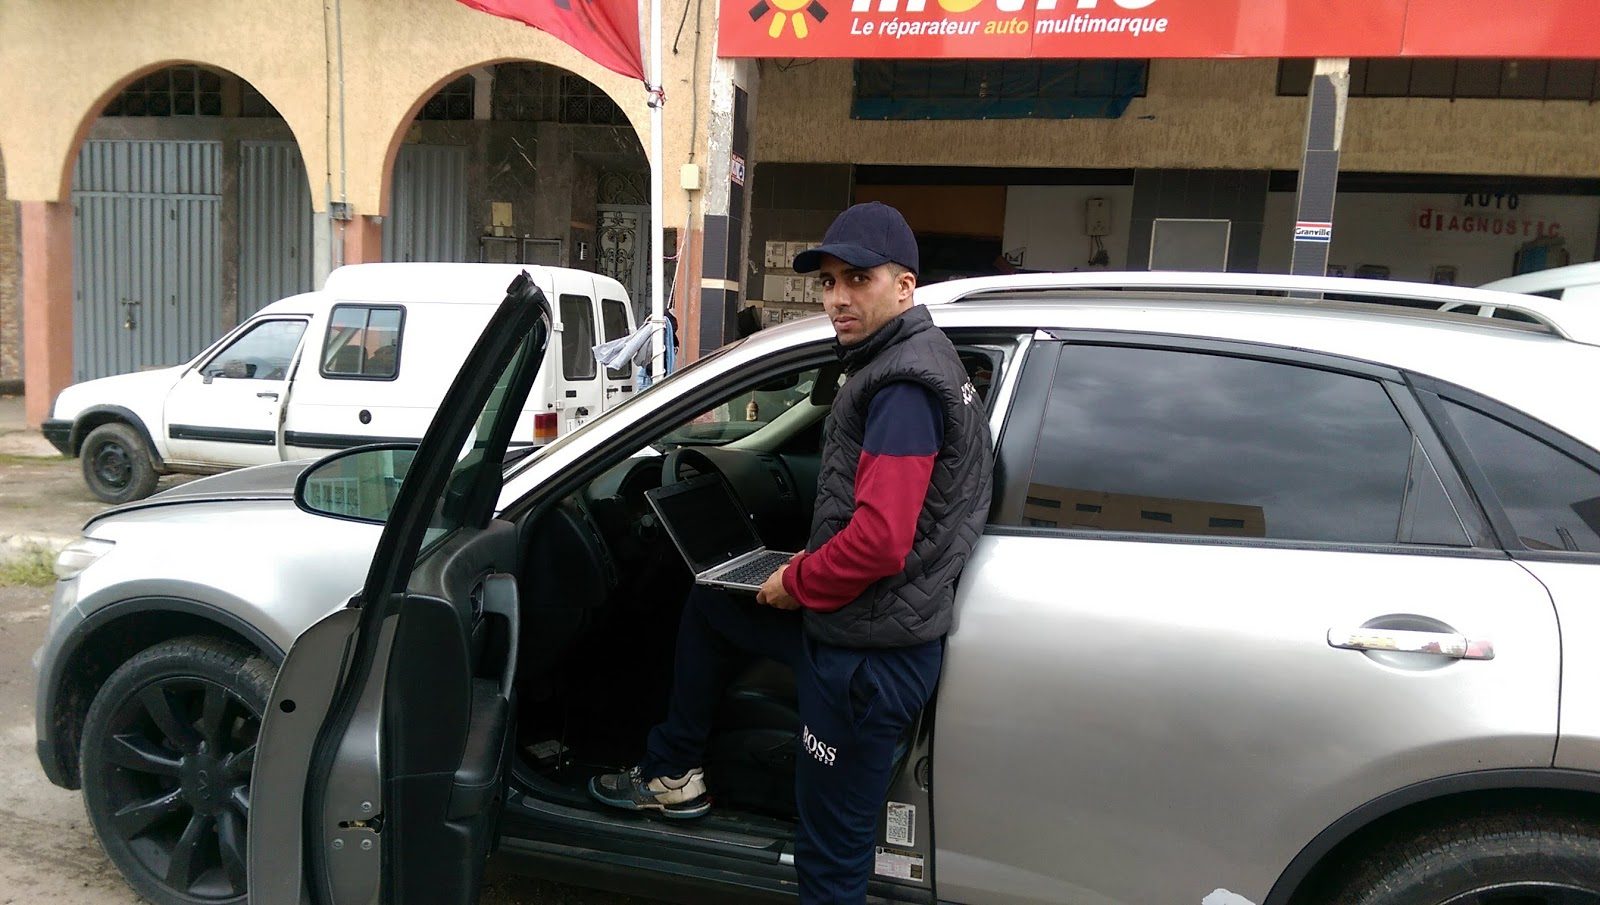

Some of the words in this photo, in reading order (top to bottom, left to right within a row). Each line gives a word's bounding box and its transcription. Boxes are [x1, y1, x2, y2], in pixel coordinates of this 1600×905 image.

[851, 17, 875, 35] Le
[878, 17, 980, 39] réparateur
[984, 16, 1029, 34] auto
[1035, 13, 1168, 37] multimarque
[1463, 192, 1520, 210] AUTO
[1295, 227, 1331, 236] Granville
[803, 725, 837, 762] BOSS
